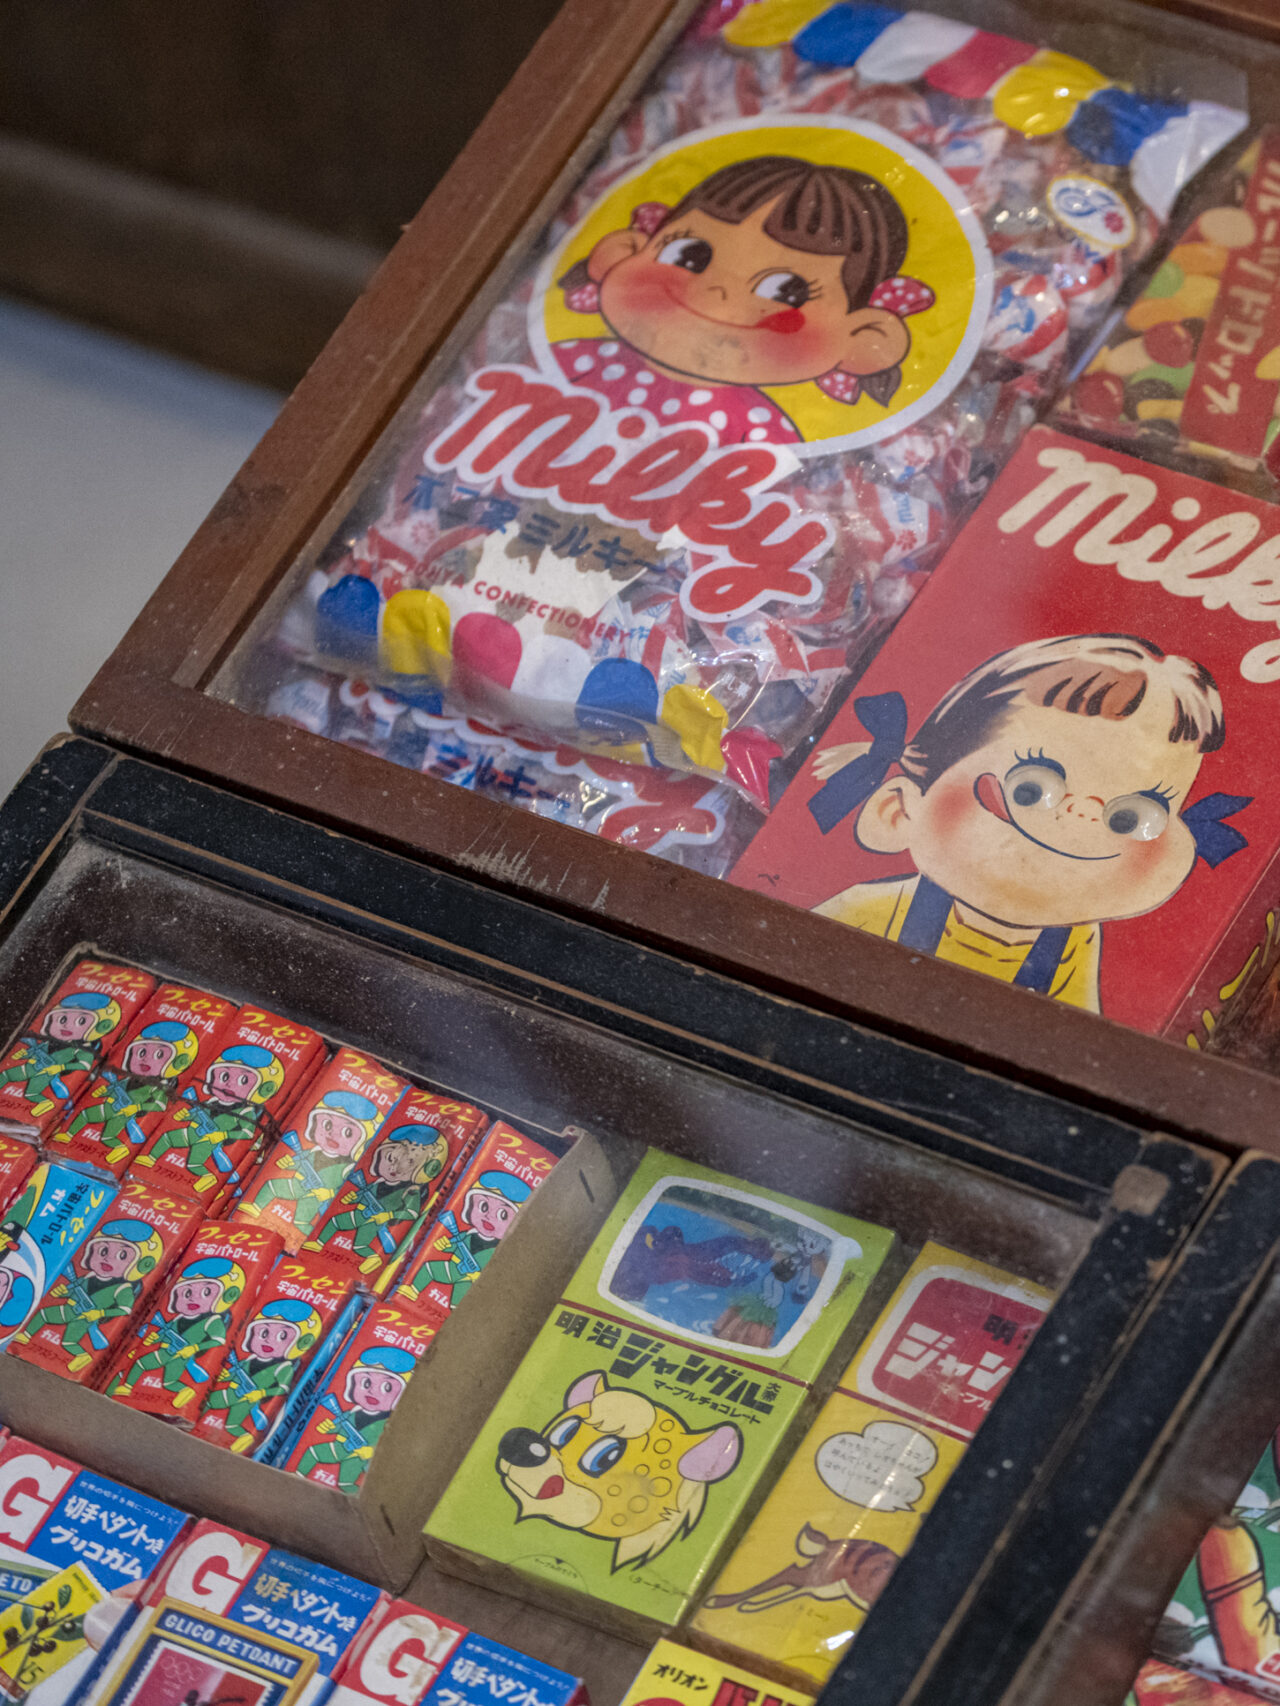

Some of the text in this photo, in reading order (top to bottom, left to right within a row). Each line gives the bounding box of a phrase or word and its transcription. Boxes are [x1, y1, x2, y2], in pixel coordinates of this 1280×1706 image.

[430, 368, 830, 617] Milky
[474, 580, 632, 644] CONFECTIONERY
[75, 977, 137, 1003] 宇宙パトロール
[82, 964, 148, 988] フーセン
[164, 989, 225, 1017] フーセン
[157, 1004, 215, 1034] 宇宙パトロール
[243, 1012, 310, 1045] フーセン
[237, 1026, 300, 1061] 宇宙パトロール
[338, 1069, 393, 1106] 宇宙パトロー
[343, 1054, 399, 1096] フーセ
[3, 1086, 24, 1097] ガム
[405, 1106, 465, 1140] 宇宙パトロール
[411, 1092, 476, 1123] フーセン
[81, 1128, 101, 1142] ガム
[165, 1152, 186, 1168] ガム
[500, 1133, 553, 1171] フーセ
[494, 1149, 543, 1188] 宇宙パトロ
[123, 1183, 193, 1218] フーセン
[271, 1204, 293, 1223] ガム
[118, 1199, 182, 1235] 宇宙パトロール
[195, 1242, 260, 1262] 宇宙パトロール
[198, 1226, 270, 1247] フーセン
[332, 1236, 353, 1250] ガム
[281, 1264, 349, 1295] フーセン
[276, 1280, 339, 1312] 宇宙パトロール
[428, 1288, 449, 1308] ガム
[40, 1328, 62, 1345] ガム
[377, 1309, 435, 1339] フーセ
[372, 1325, 426, 1356] 宇宙パトロ
[555, 1310, 774, 1415] 明治 ジャングル
[884, 1322, 1012, 1392] ジャン
[142, 1376, 162, 1389] ガム
[653, 1379, 761, 1425] マーブルチョコレート
[203, 1415, 224, 1429] ガム
[313, 1469, 337, 1487] ガム
[0, 1454, 74, 1544] G
[49, 1525, 143, 1580] グリコガム
[165, 1531, 263, 1617] G
[164, 1614, 298, 1673] GLICO PETDANT
[241, 1604, 338, 1657] グリコガム
[360, 1614, 461, 1706] G
[653, 1663, 709, 1691] オリオン
